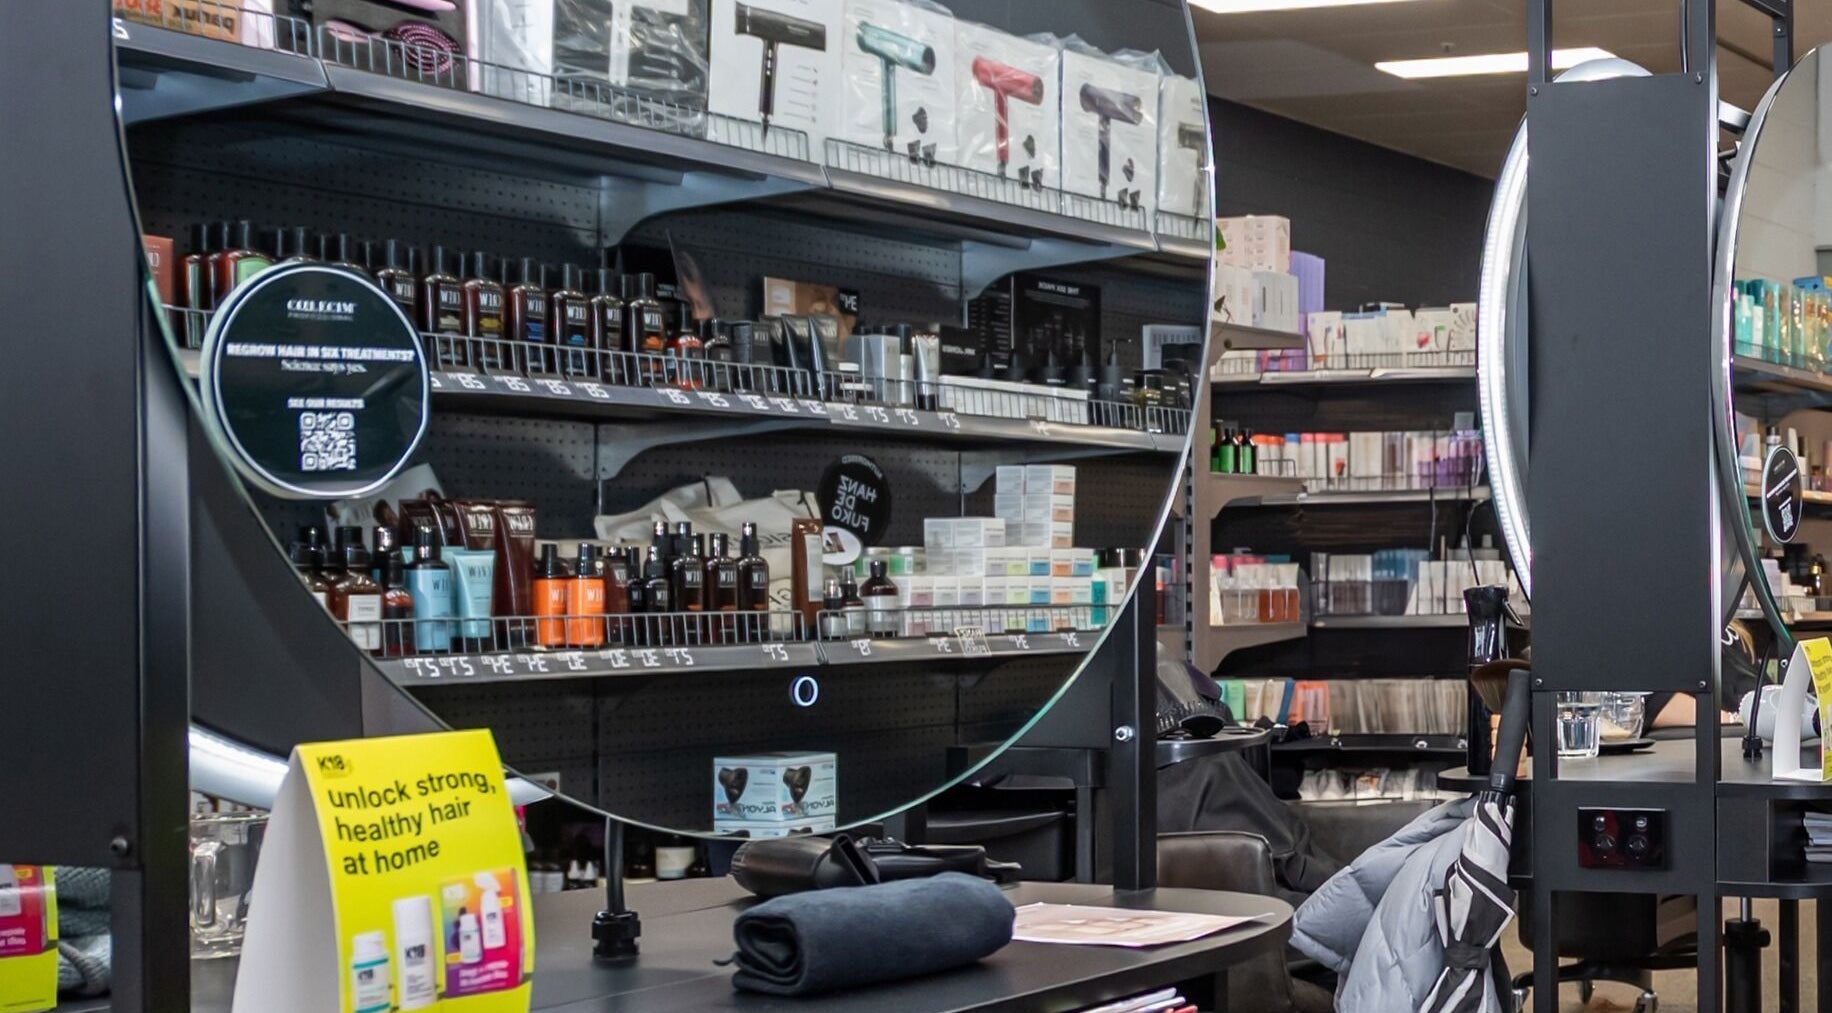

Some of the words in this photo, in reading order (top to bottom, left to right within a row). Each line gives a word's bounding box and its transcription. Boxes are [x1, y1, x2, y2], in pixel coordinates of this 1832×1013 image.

[226, 343, 275, 358] REGROW
[277, 344, 306, 358] HAIR
[307, 345, 319, 359] IN
[321, 346, 340, 360] SIX
[288, 397, 304, 409] SEE
[326, 397, 365, 409] RESULTS
[316, 755, 346, 771] K18
[328, 779, 411, 809] unlock
[416, 772, 496, 797] strong,
[334, 812, 422, 842] healthy
[428, 796, 471, 825] hair
[343, 852, 368, 876] at
[375, 840, 440, 874] home
